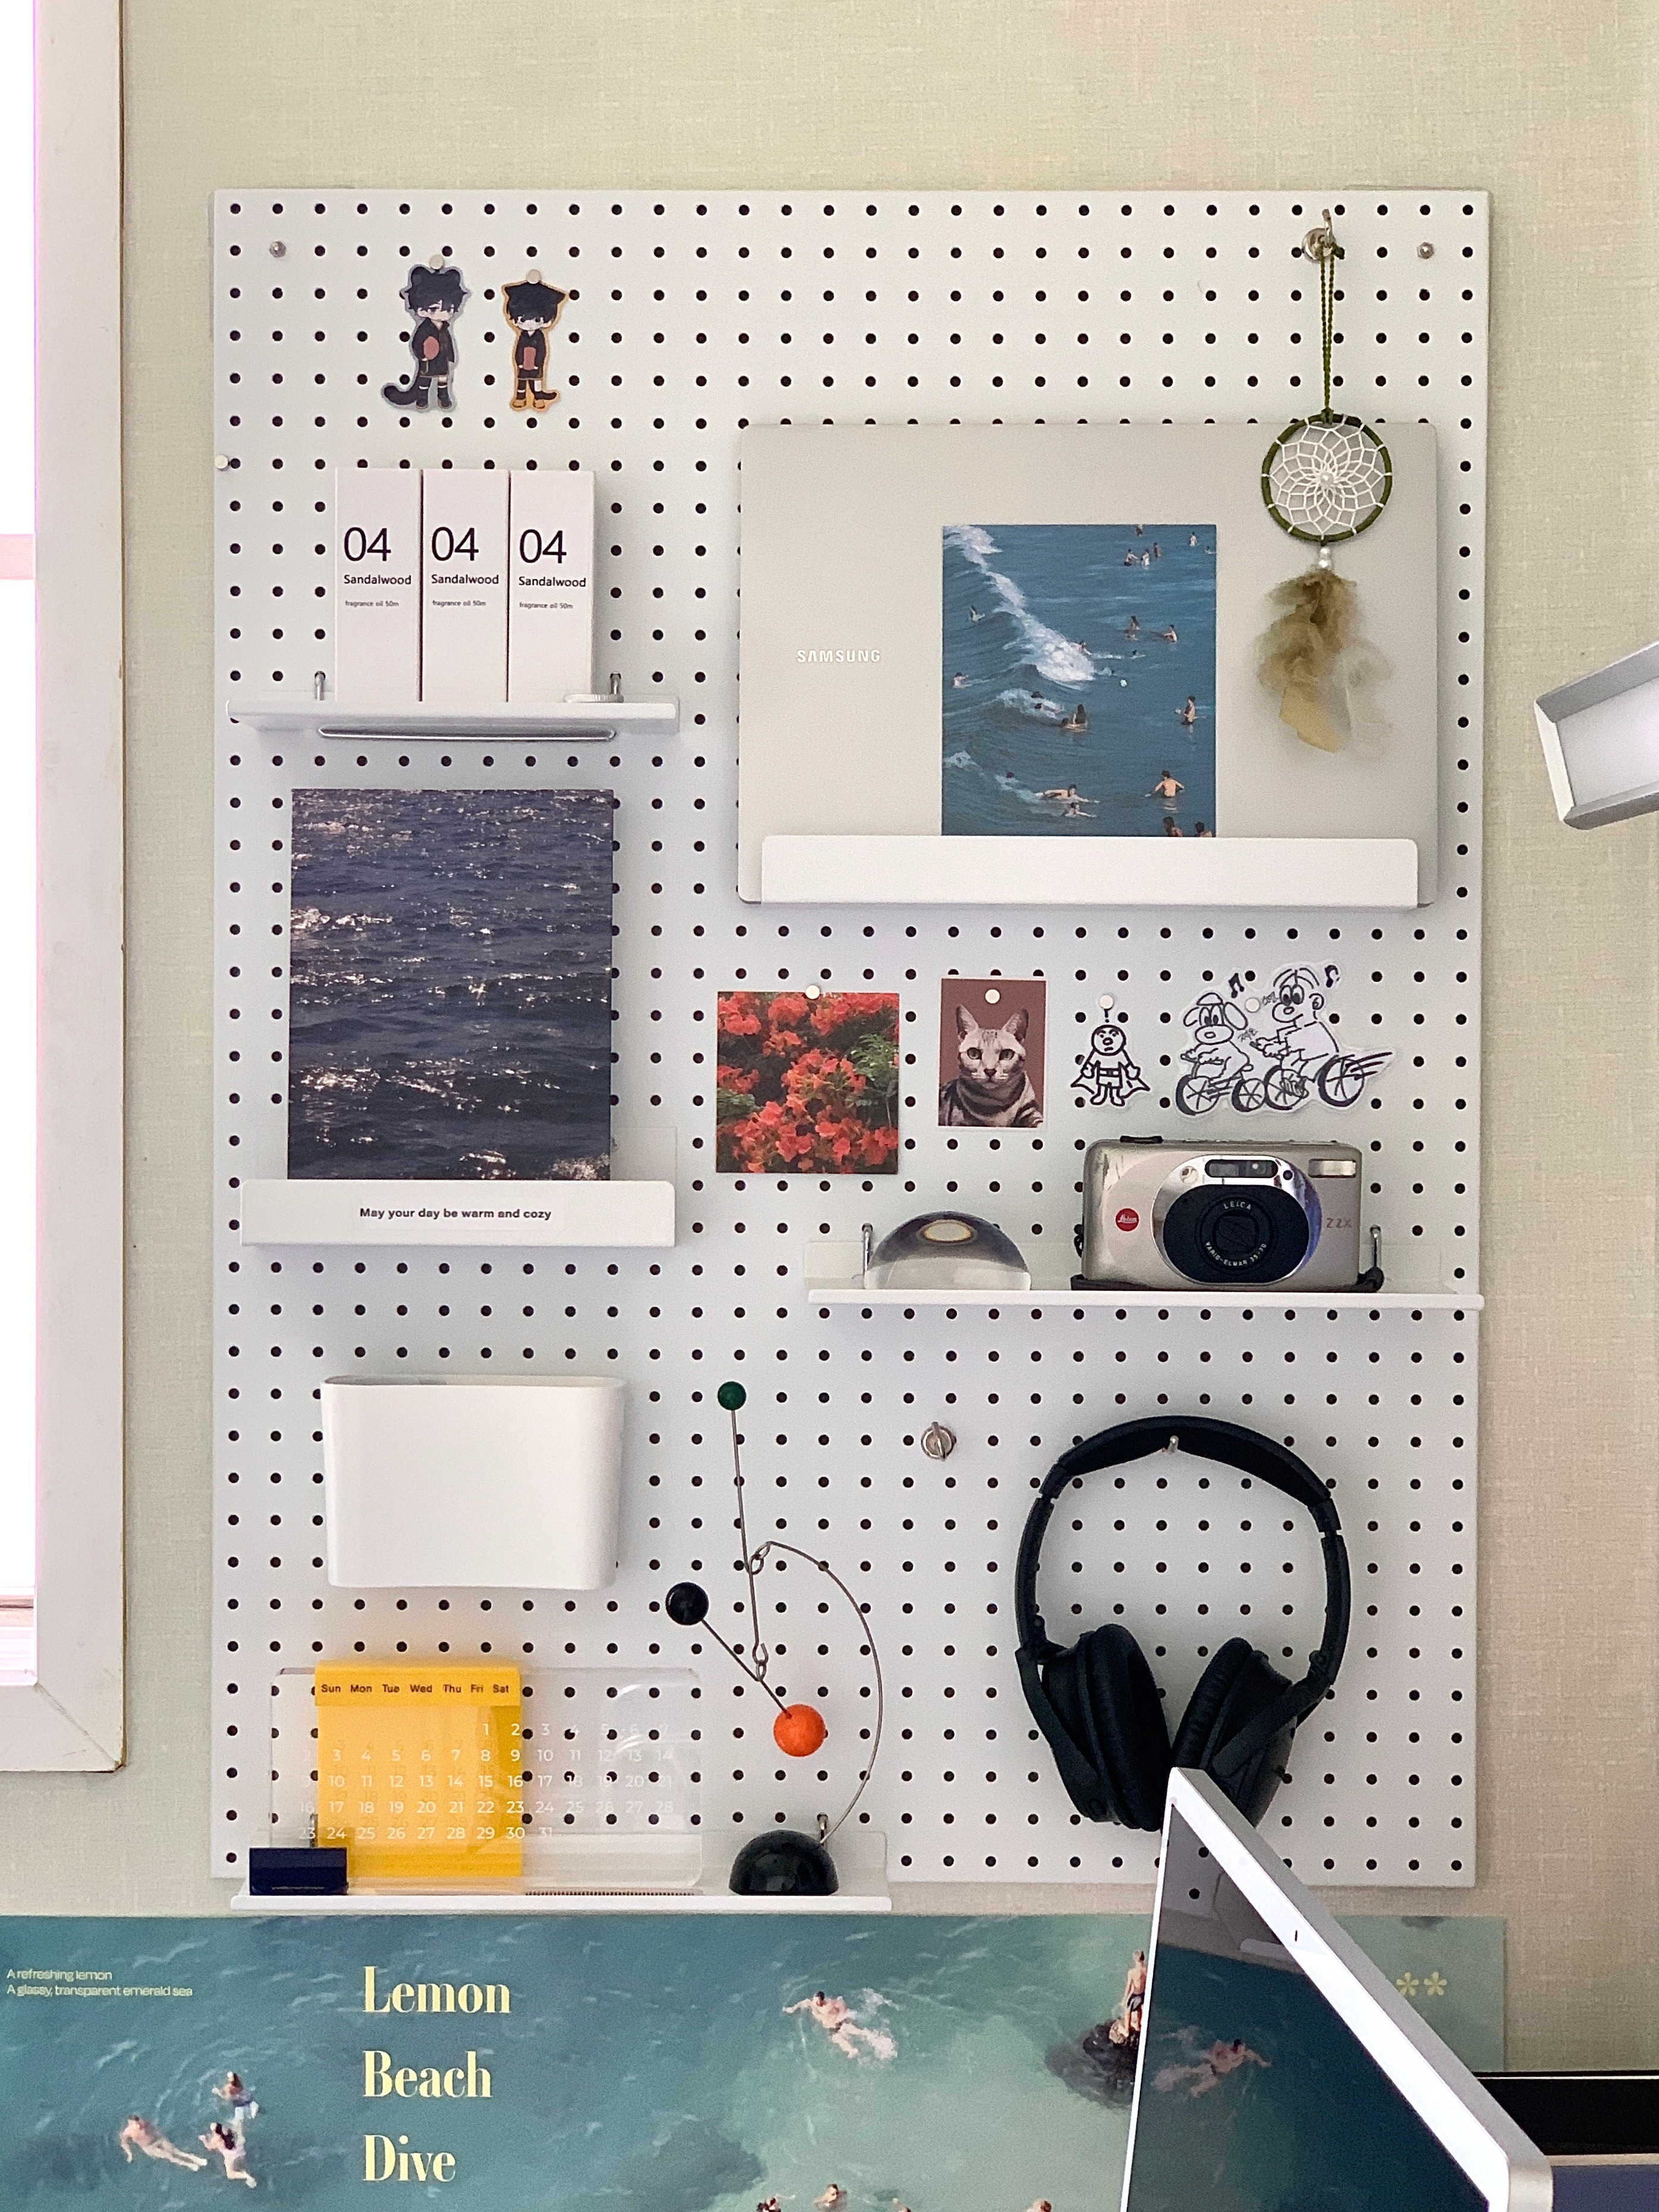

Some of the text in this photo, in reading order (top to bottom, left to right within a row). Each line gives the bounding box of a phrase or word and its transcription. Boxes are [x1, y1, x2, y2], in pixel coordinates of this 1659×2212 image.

[343, 526, 391, 561] 04
[431, 526, 479, 561] 04
[519, 529, 567, 564] 04
[344, 574, 411, 585] Sandalwood
[431, 573, 499, 585] Sandalwood
[519, 576, 586, 587] Sandalwood
[797, 649, 880, 662] SAMSUNG
[1224, 1201, 1251, 1210] LEICA
[360, 1208, 385, 1220] May
[388, 1209, 415, 1220] your
[418, 1208, 440, 1220] day
[444, 1208, 458, 1218] be
[498, 1208, 520, 1218] and
[523, 1210, 551, 1221] cozy
[321, 1684, 509, 1693] Sun Mon Tue Wed Thu Fri Sat
[483, 1723, 489, 1736] 1
[511, 1723, 520, 1736] 2
[541, 1723, 549, 1736] 3
[332, 1749, 341, 1762] 3
[361, 1749, 372, 1762] 4
[392, 1749, 401, 1762] 5
[421, 1749, 431, 1762] 6
[451, 1749, 461, 1762] 7
[480, 1749, 491, 1762] 8
[510, 1749, 520, 1762] 9
[538, 1749, 553, 1762] 10
[329, 1775, 345, 1787] 10
[362, 1775, 372, 1787] 11
[389, 1775, 404, 1787] 12
[419, 1775, 433, 1787] 13
[448, 1775, 463, 1787] 14
[478, 1775, 493, 1787] 15
[507, 1775, 523, 1787] 16
[538, 1775, 552, 1787] 17
[625, 1775, 644, 1787] 20
[329, 1801, 344, 1814] 17
[359, 1801, 375, 1814] 18
[389, 1801, 404, 1814] 19
[417, 1801, 436, 1814] 20
[449, 1801, 463, 1814] 21
[477, 1801, 494, 1814] 22
[507, 1801, 524, 1814] 23
[536, 1801, 554, 1814] 24
[567, 1801, 584, 1814] 25
[327, 1827, 347, 1839] 24
[357, 1827, 375, 1839] 25
[387, 1827, 406, 1839] 26
[417, 1827, 435, 1839] 27
[447, 1827, 466, 1839] 28
[476, 1827, 495, 1839] 29
[506, 1827, 524, 1839] 30
[7, 1969, 112, 1982] A refreshing lemon
[7, 1984, 193, 1997] A glassy, transparent emerald sea
[363, 1965, 511, 2013] Lemon
[363, 2050, 493, 2098] Beach
[363, 2134, 456, 2182] Dive
